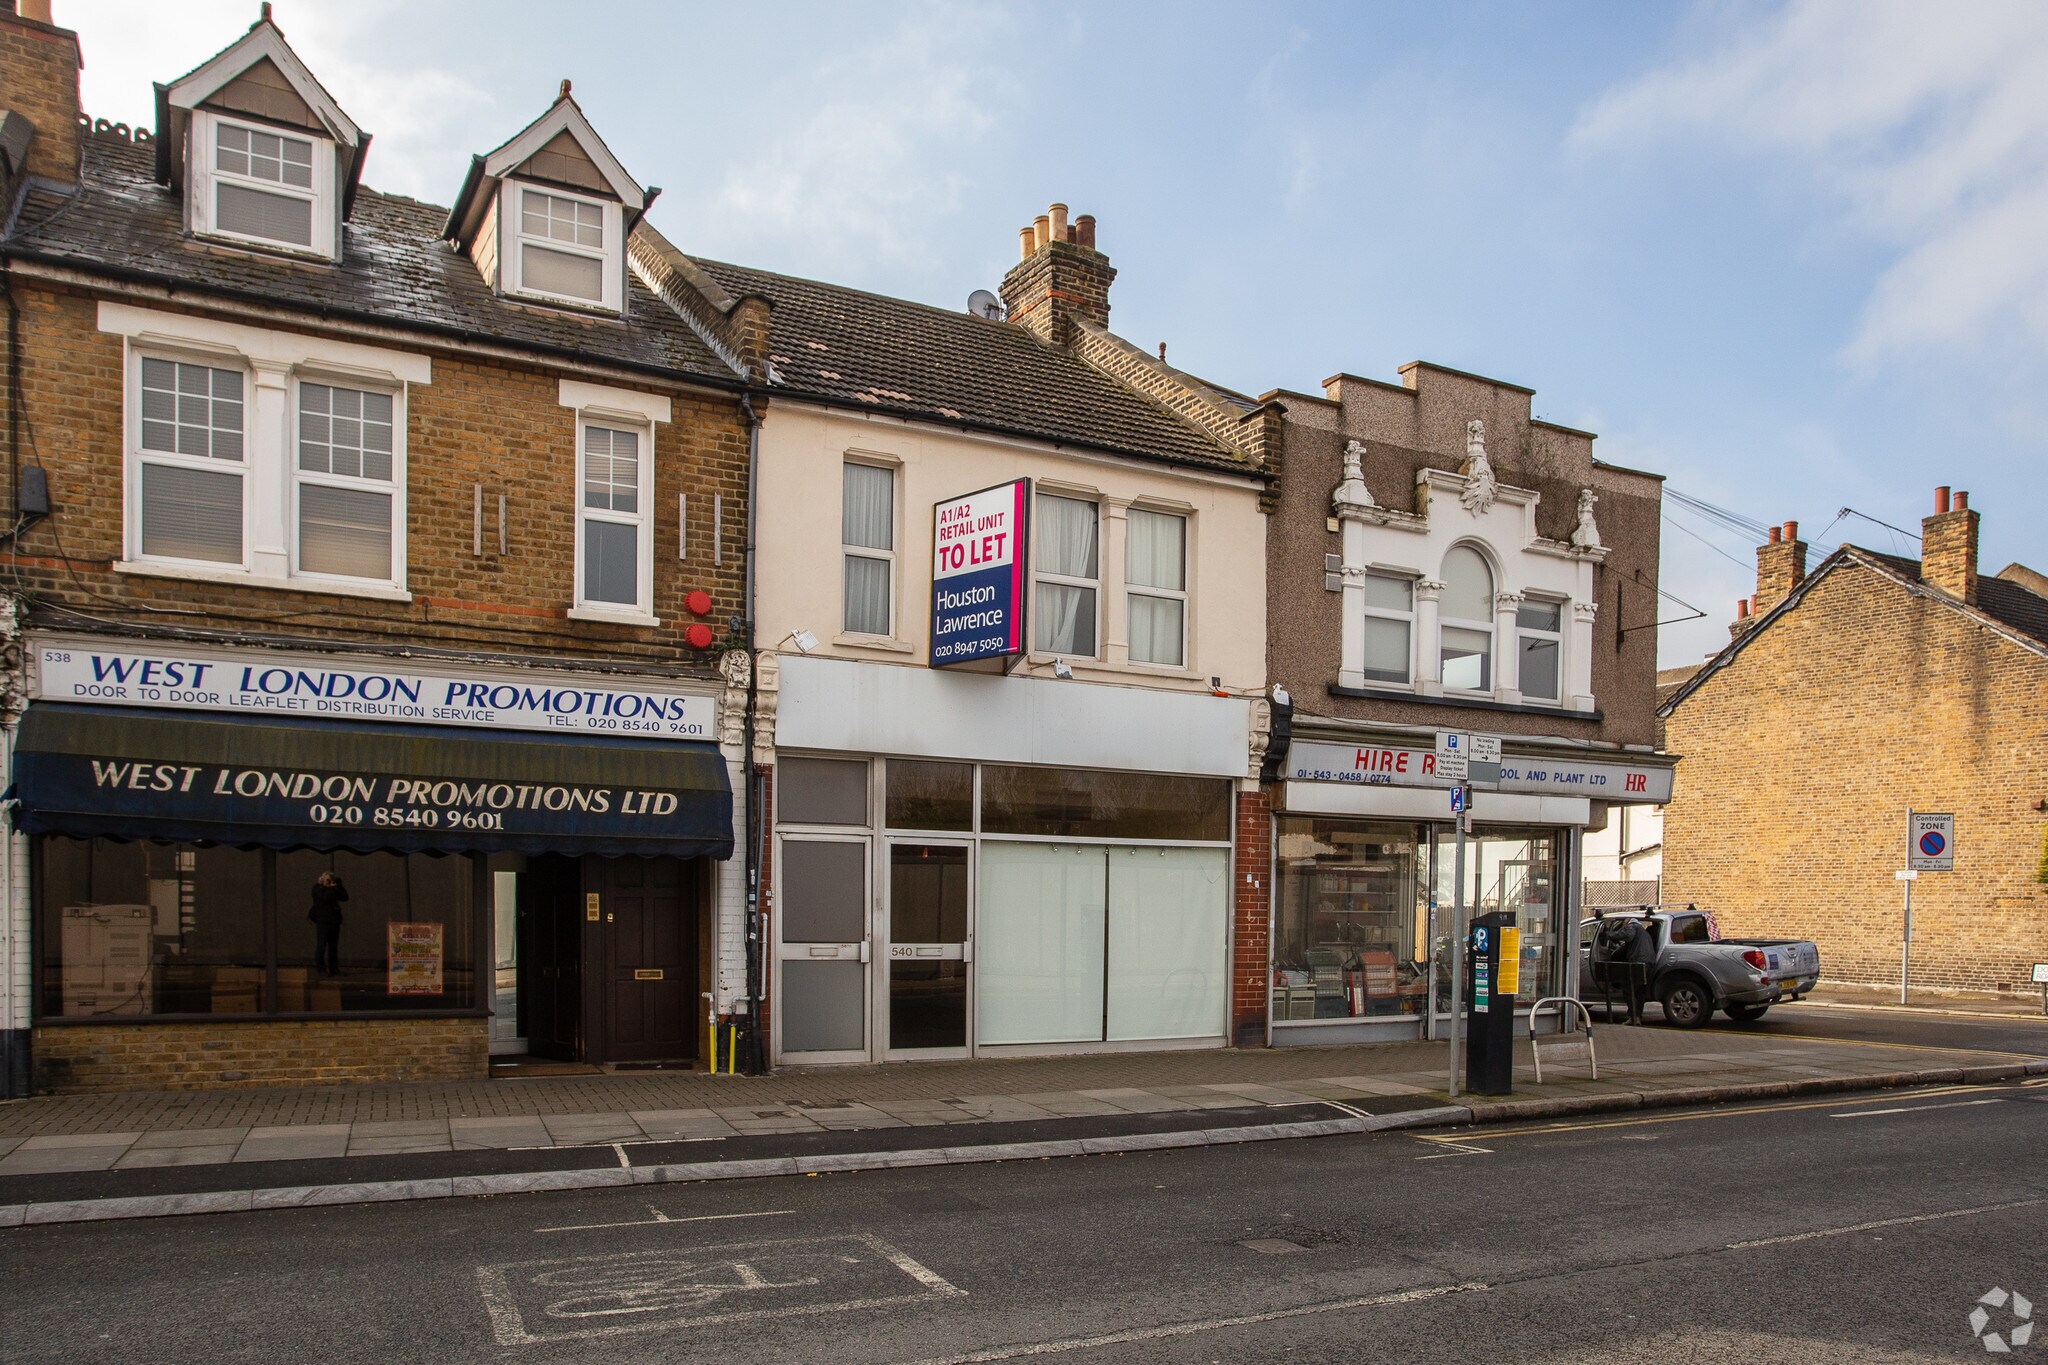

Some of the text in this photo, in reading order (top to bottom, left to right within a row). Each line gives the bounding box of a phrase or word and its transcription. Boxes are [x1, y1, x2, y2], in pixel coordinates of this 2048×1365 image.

[939, 504, 971, 525] A1/A2
[939, 512, 1005, 541] RETAIL UNIT
[938, 532, 1007, 572] TO LET
[937, 585, 995, 611] Houston
[935, 608, 1003, 635] Lawrence
[44, 651, 72, 663] 538
[935, 644, 953, 658] 020
[954, 640, 978, 655] 8947
[979, 636, 1004, 652] 5050
[90, 655, 686, 721] WEST LONDON PROMOTIONS
[74, 683, 496, 722] DOOR TO DOOR LEAFLET DISTRIBUTION SERVICE
[546, 714, 704, 735] TEL: 020 8540 9601
[1354, 748, 1410, 773] HIRE
[1500, 768, 1520, 780] OOL
[1526, 770, 1547, 782] AND
[1553, 772, 1585, 784] PLANT
[1589, 774, 1607, 785] LTD
[1370, 774, 1391, 784] 0774
[90, 760, 679, 816] WEST LONDON PROMOTIONS LTD
[1624, 773, 1648, 792] HR
[309, 803, 505, 831] 020 8540 9601
[1920, 822, 1945, 830] ZONE
[891, 947, 913, 957] 540
